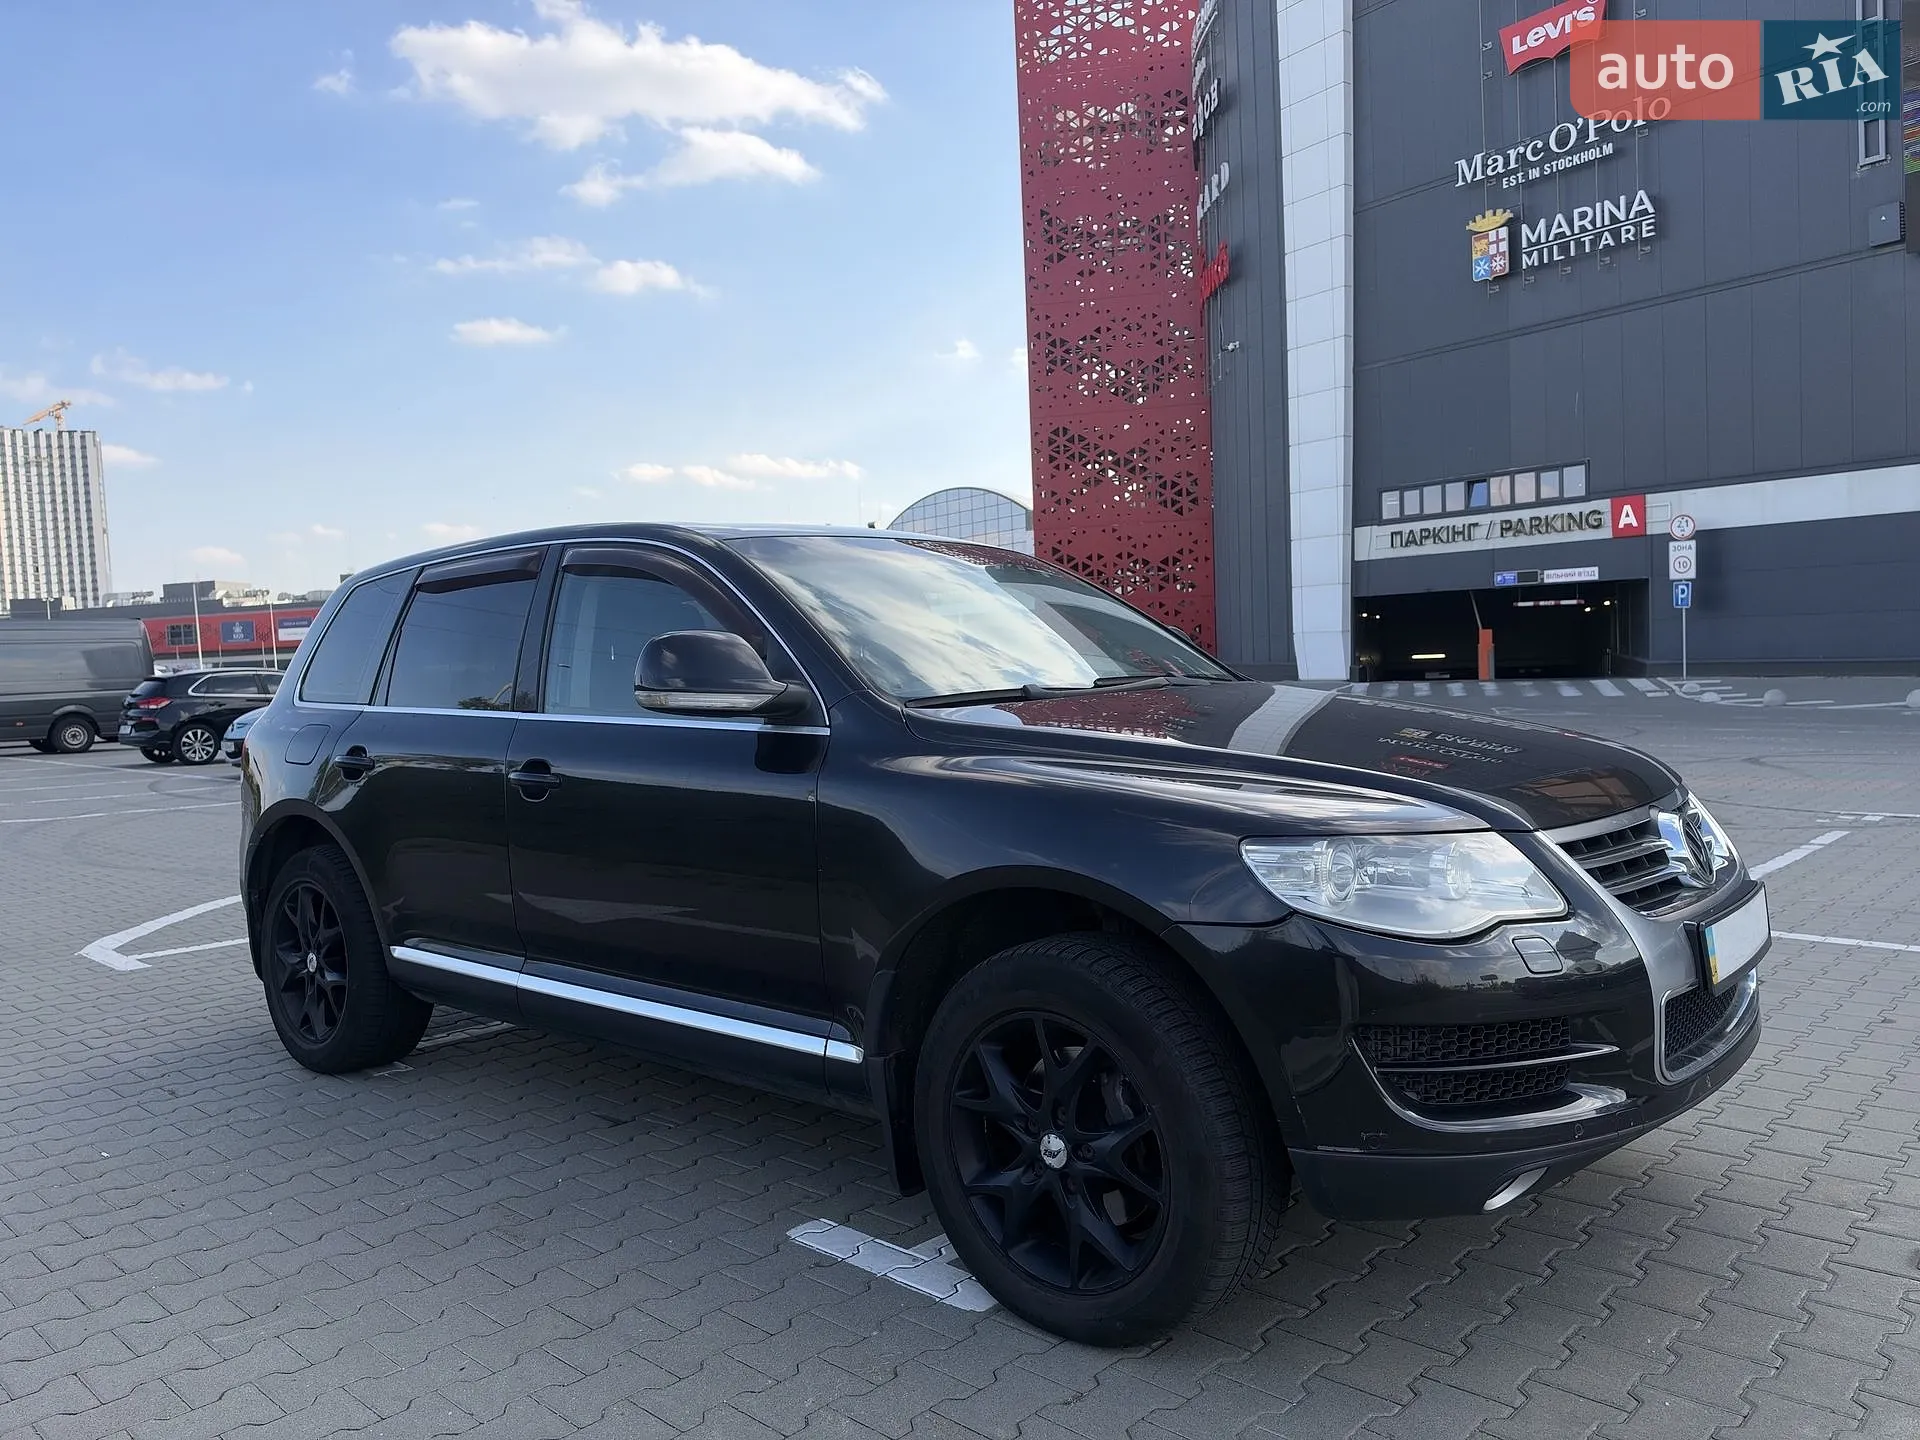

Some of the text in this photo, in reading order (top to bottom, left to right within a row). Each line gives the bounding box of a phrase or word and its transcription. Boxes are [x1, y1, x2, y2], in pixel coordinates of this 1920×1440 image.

[1454, 96, 1671, 188] Marc O'Polo
[1502, 142, 1614, 189] EST. IN STOCKHOLM
[1521, 189, 1656, 248] MARINA
[1522, 218, 1656, 269] MILITARE
[1390, 522, 1479, 548] ПАРКІНГ
[1500, 509, 1604, 538] PARKING
[1677, 561, 1688, 569] 10
